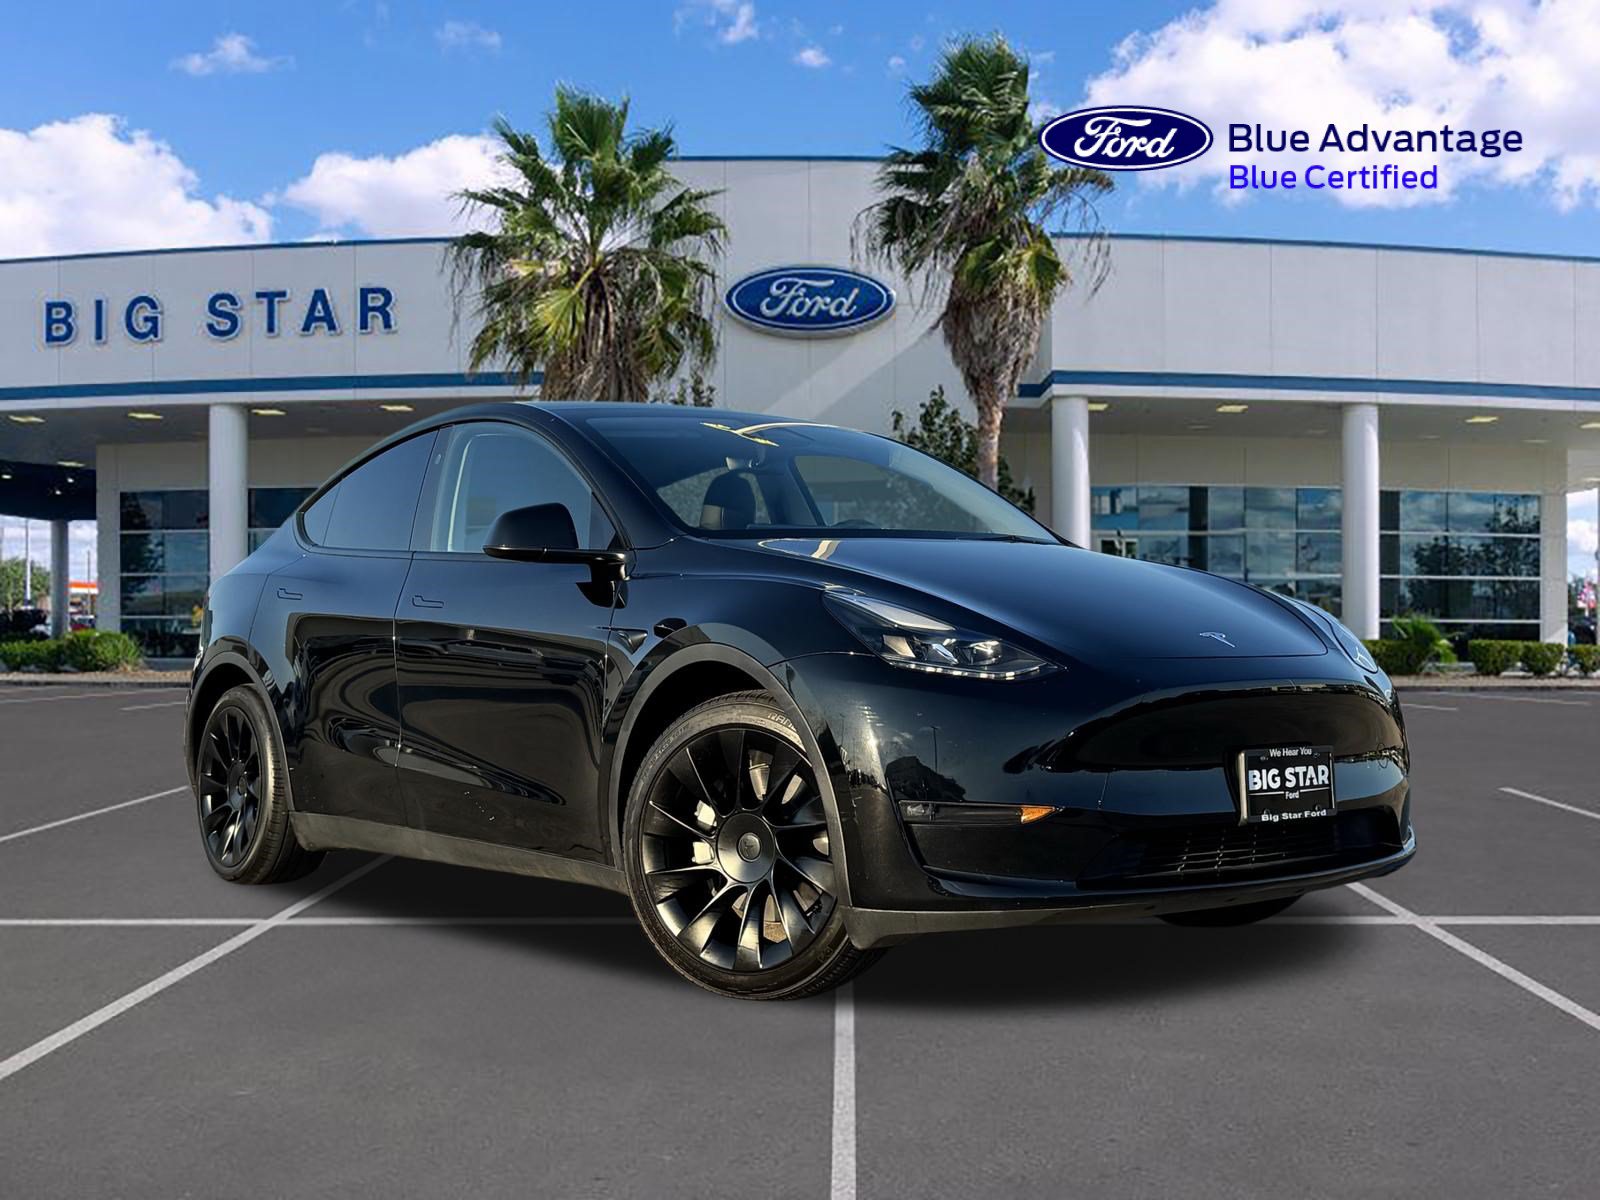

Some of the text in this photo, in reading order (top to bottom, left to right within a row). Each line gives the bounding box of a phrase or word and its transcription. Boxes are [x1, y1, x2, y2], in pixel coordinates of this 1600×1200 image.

[759, 277, 859, 318] Ford
[44, 286, 397, 346] BIG STAR
[1269, 746, 1312, 757] We Hear You
[1248, 765, 1329, 791] BIG STAR
[1285, 790, 1300, 800] Ford
[1261, 809, 1327, 823] Big Star Ford
